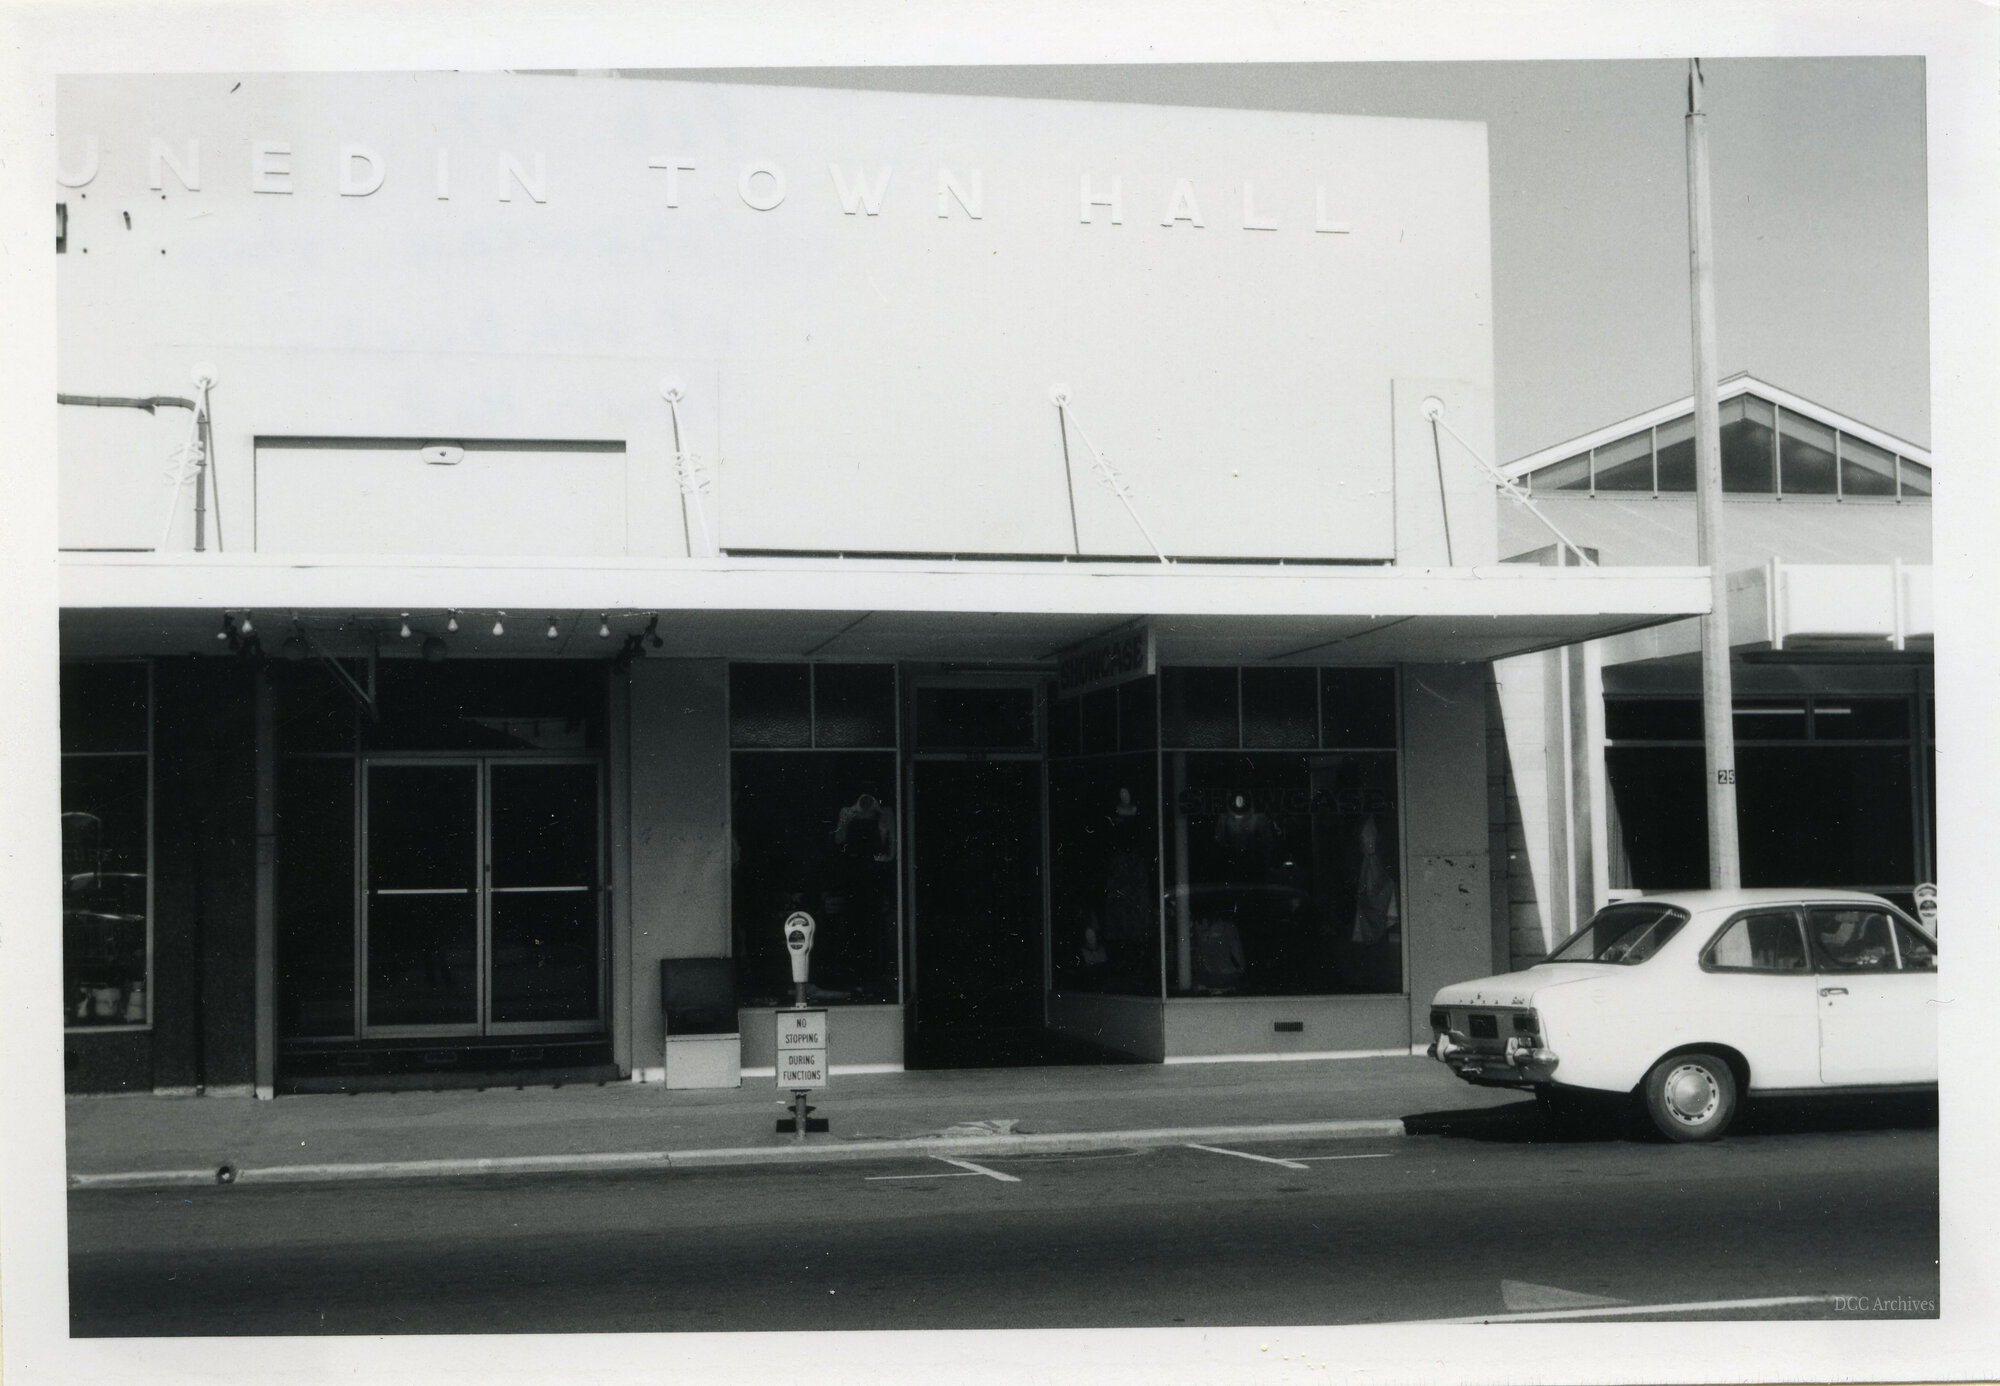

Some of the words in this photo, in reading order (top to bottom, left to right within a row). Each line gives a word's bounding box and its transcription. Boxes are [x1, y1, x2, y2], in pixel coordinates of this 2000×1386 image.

[649, 157, 983, 220] TOWN
[1080, 174, 1350, 234] HALL
[1060, 635, 1143, 689] SHOWCASE
[1178, 788, 1385, 813] SHOWCASE
[796, 1018, 807, 1028] NO
[785, 1033, 819, 1044] STOPPING
[788, 1055, 815, 1066] DURING
[783, 1070, 821, 1080] FUNCTIONS
